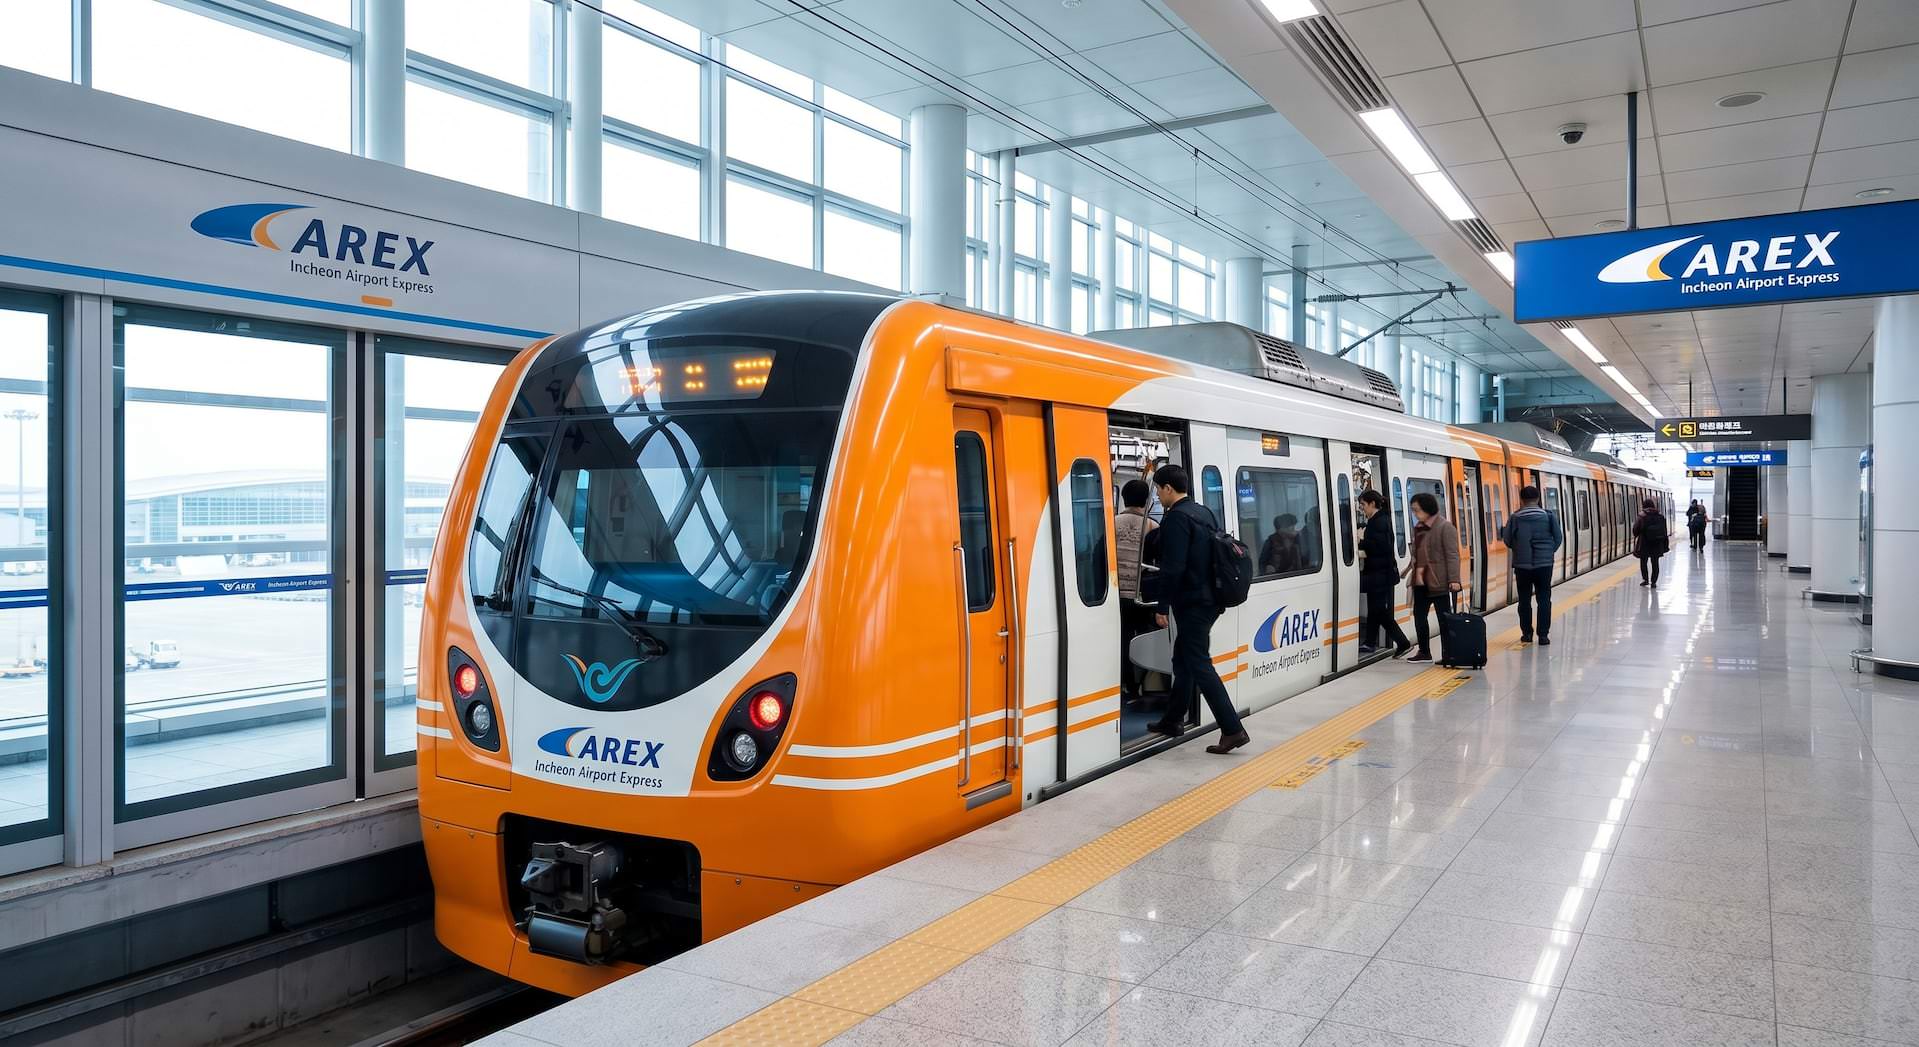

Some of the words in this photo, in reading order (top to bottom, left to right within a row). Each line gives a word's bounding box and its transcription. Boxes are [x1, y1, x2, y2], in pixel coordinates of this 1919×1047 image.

[291, 218, 435, 276] AREX
[1681, 231, 1840, 278] AREX
[291, 260, 341, 279] Incheon
[346, 270, 389, 287] Airport
[392, 276, 433, 293] Express
[1681, 280, 1732, 294] Incheon
[1736, 276, 1783, 292] Airport
[1788, 272, 1839, 288] Express
[235, 583, 256, 591] AREX
[1280, 609, 1320, 648] AREX
[1252, 661, 1277, 679] Incheon
[1278, 654, 1299, 671] Airport
[1300, 648, 1320, 664] Express
[578, 735, 664, 768] AREX
[535, 760, 575, 776] Incheon
[579, 766, 616, 783] Airport
[620, 772, 662, 788] Express
